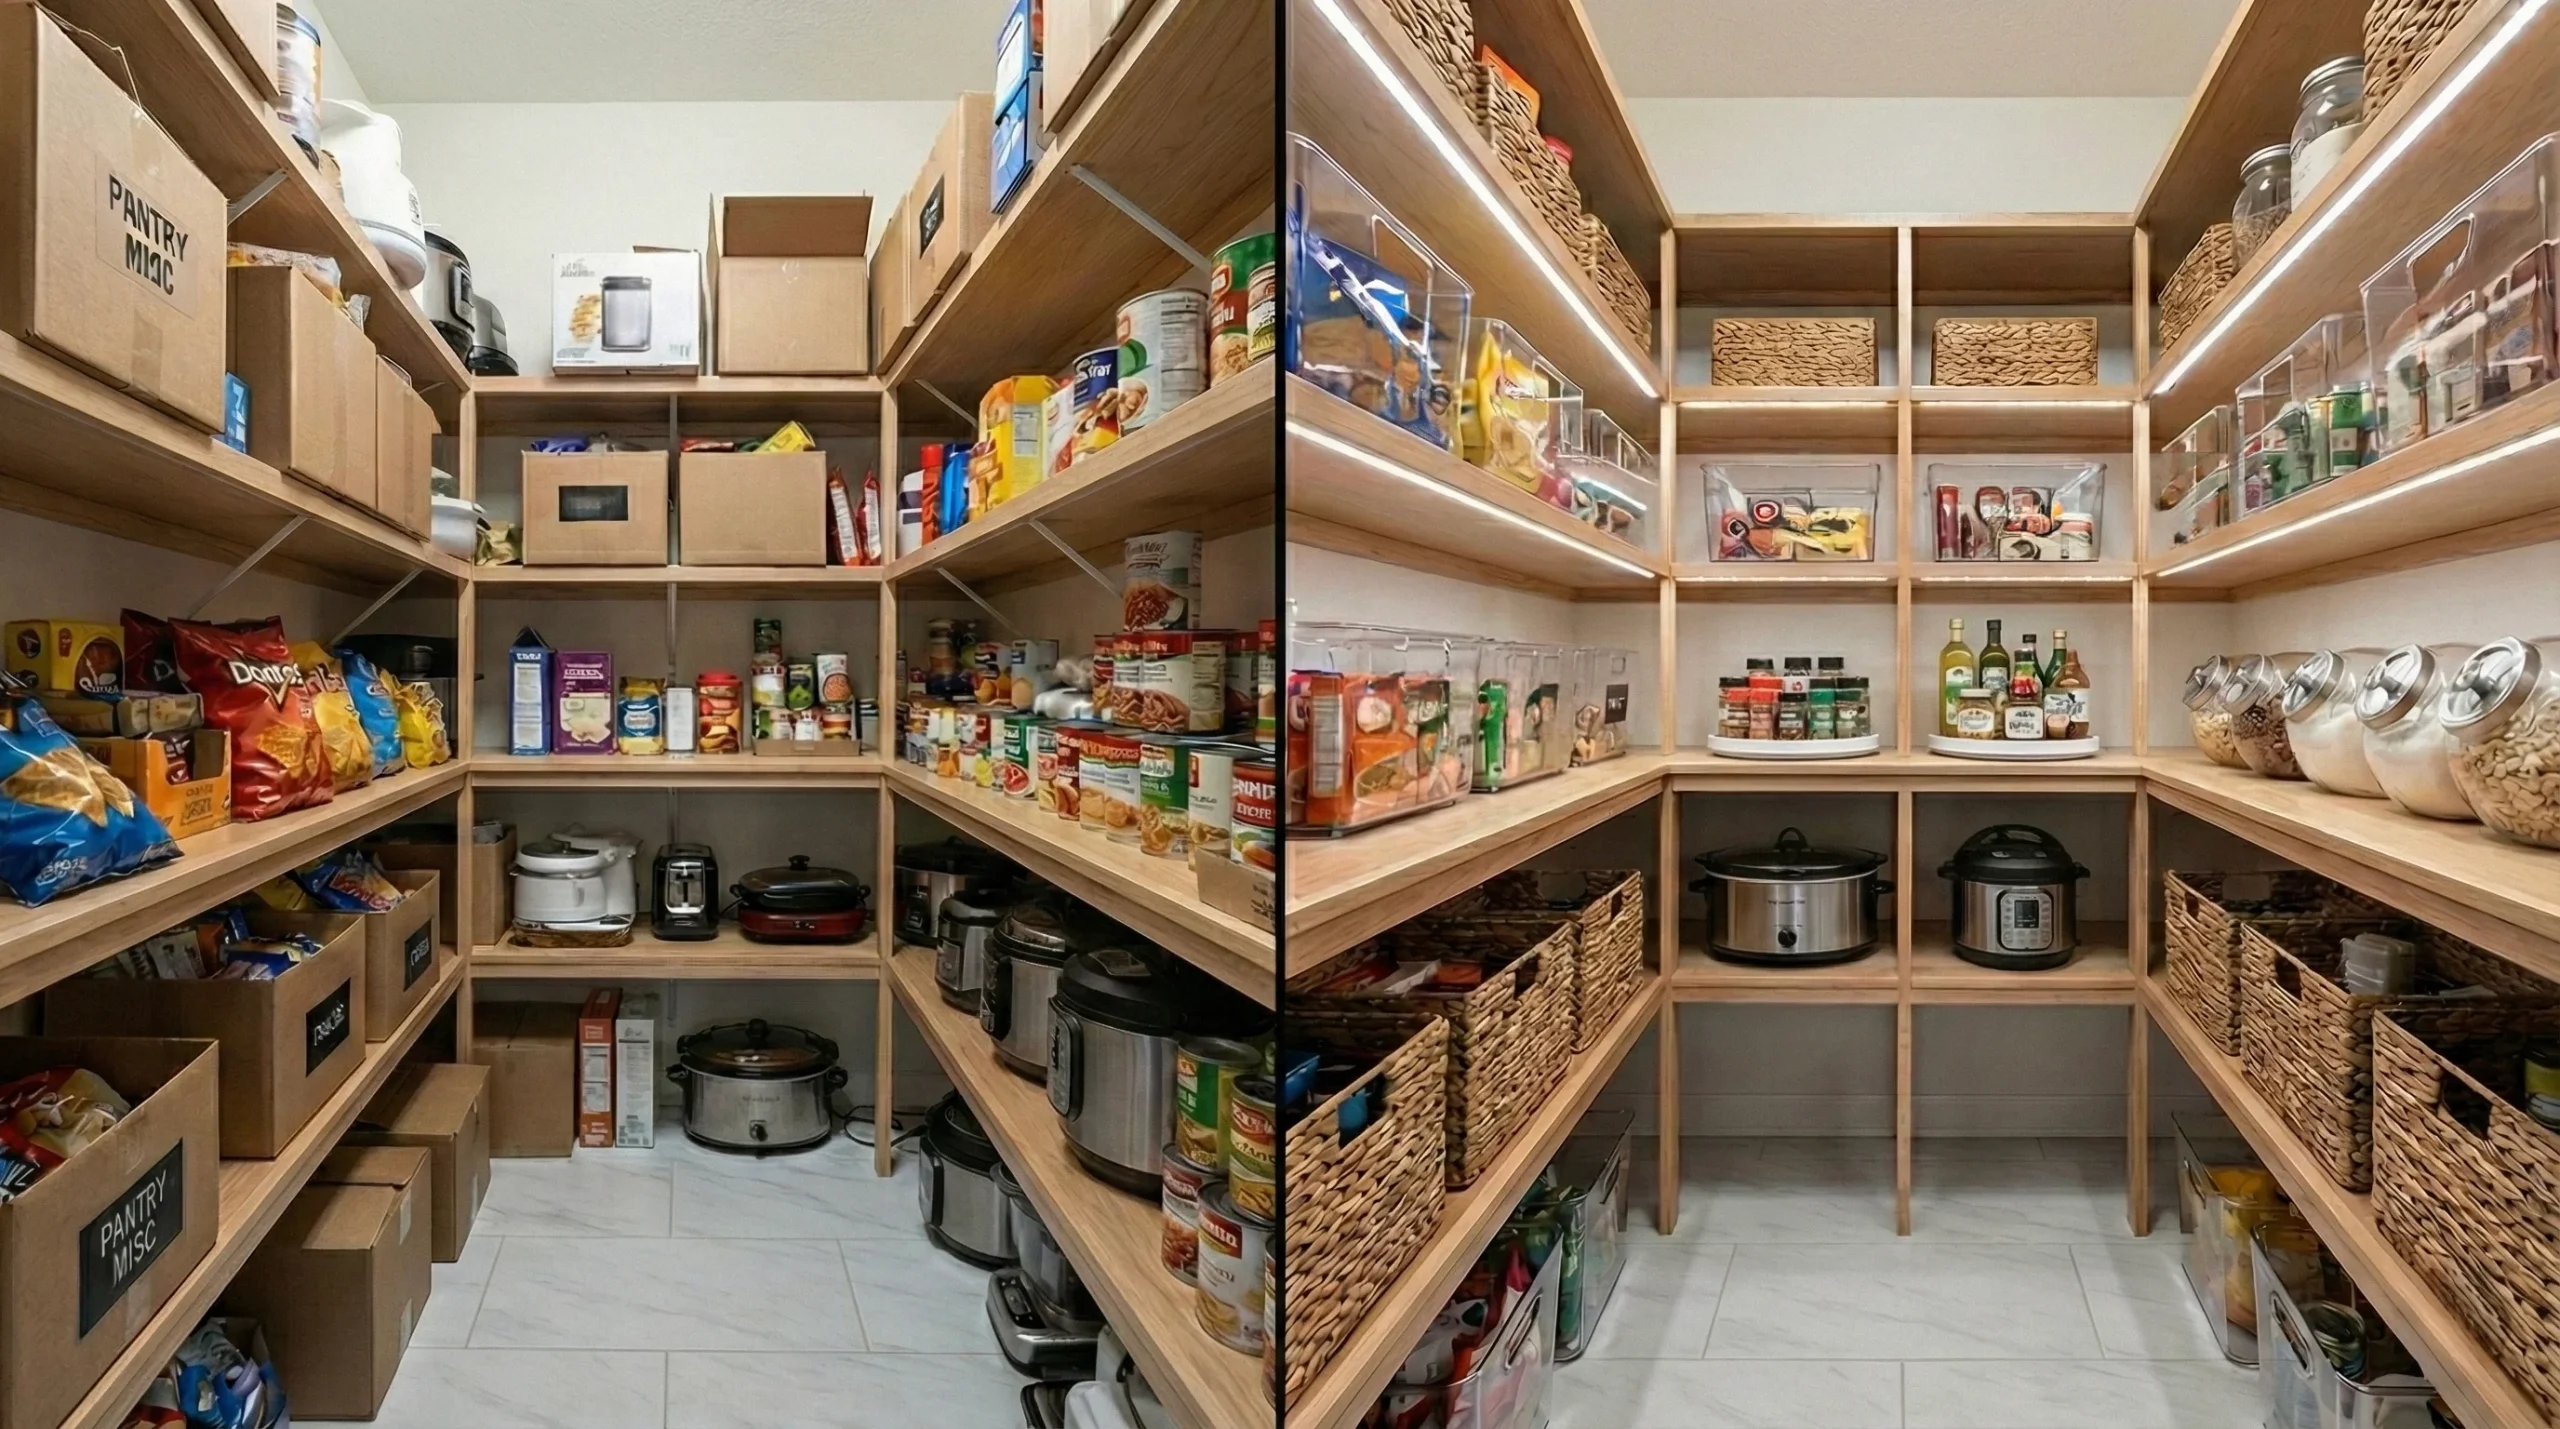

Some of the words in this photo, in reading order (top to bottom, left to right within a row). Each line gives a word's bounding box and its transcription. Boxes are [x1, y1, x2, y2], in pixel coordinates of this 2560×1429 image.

[109, 173, 188, 262] PANTRY
[101, 1169, 167, 1258] PANTRY
[112, 1219, 157, 1288] MISC
